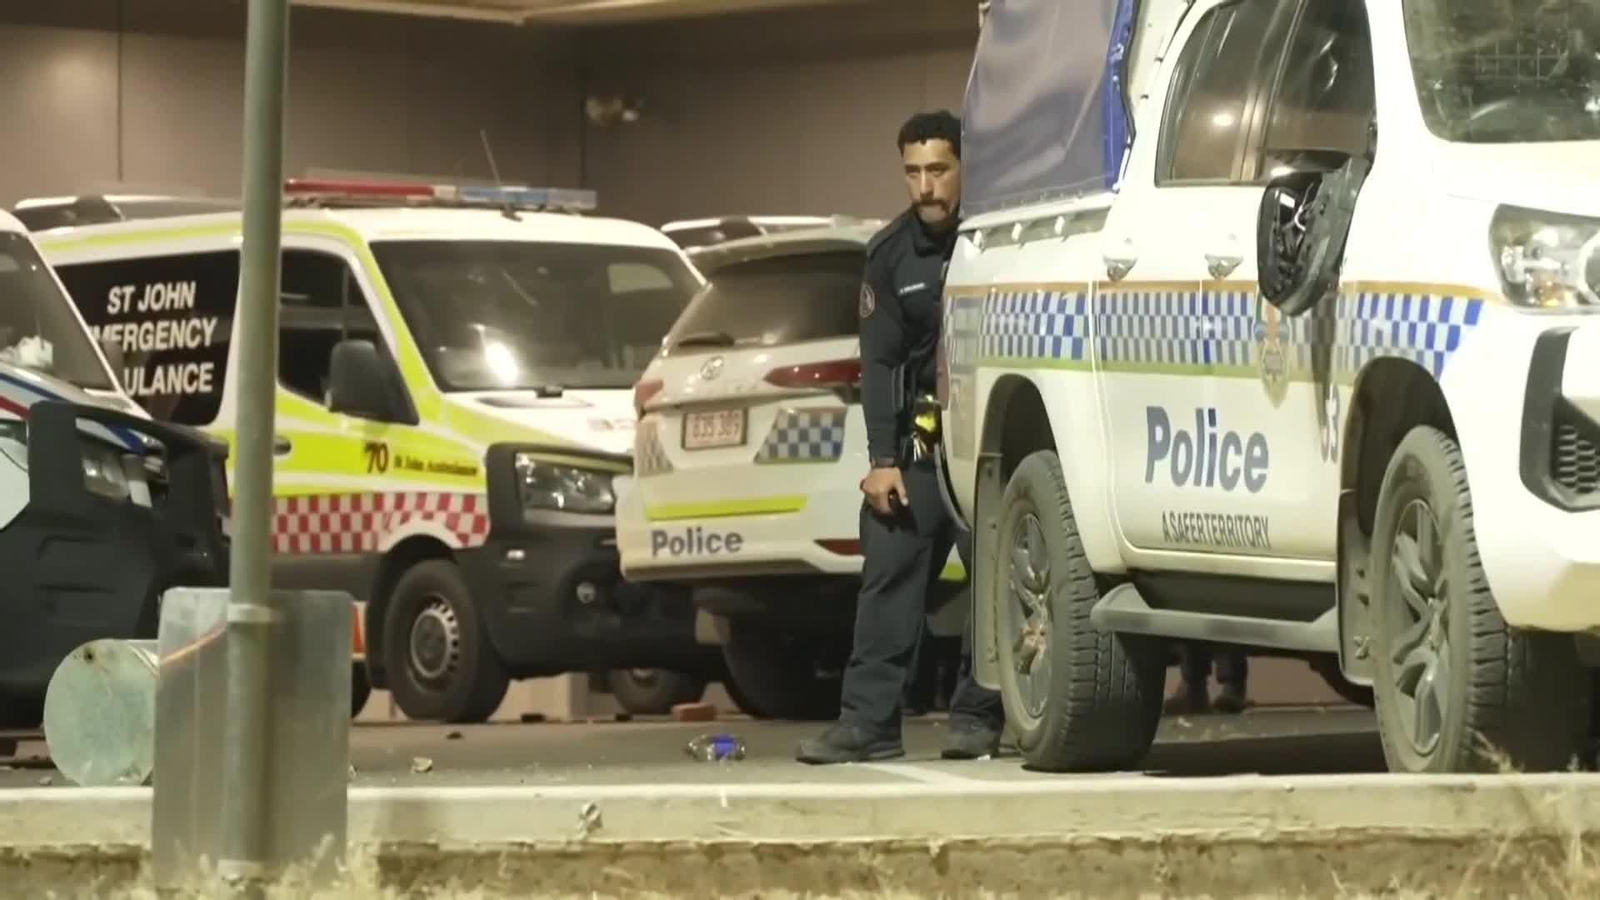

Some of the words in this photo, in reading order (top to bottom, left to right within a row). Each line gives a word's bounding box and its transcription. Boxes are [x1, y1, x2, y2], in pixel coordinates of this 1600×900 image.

[107, 284, 136, 315] ST
[138, 281, 195, 311] JOHN
[364, 441, 389, 474] 70
[1145, 406, 1269, 493] Police
[651, 526, 744, 558] Police
